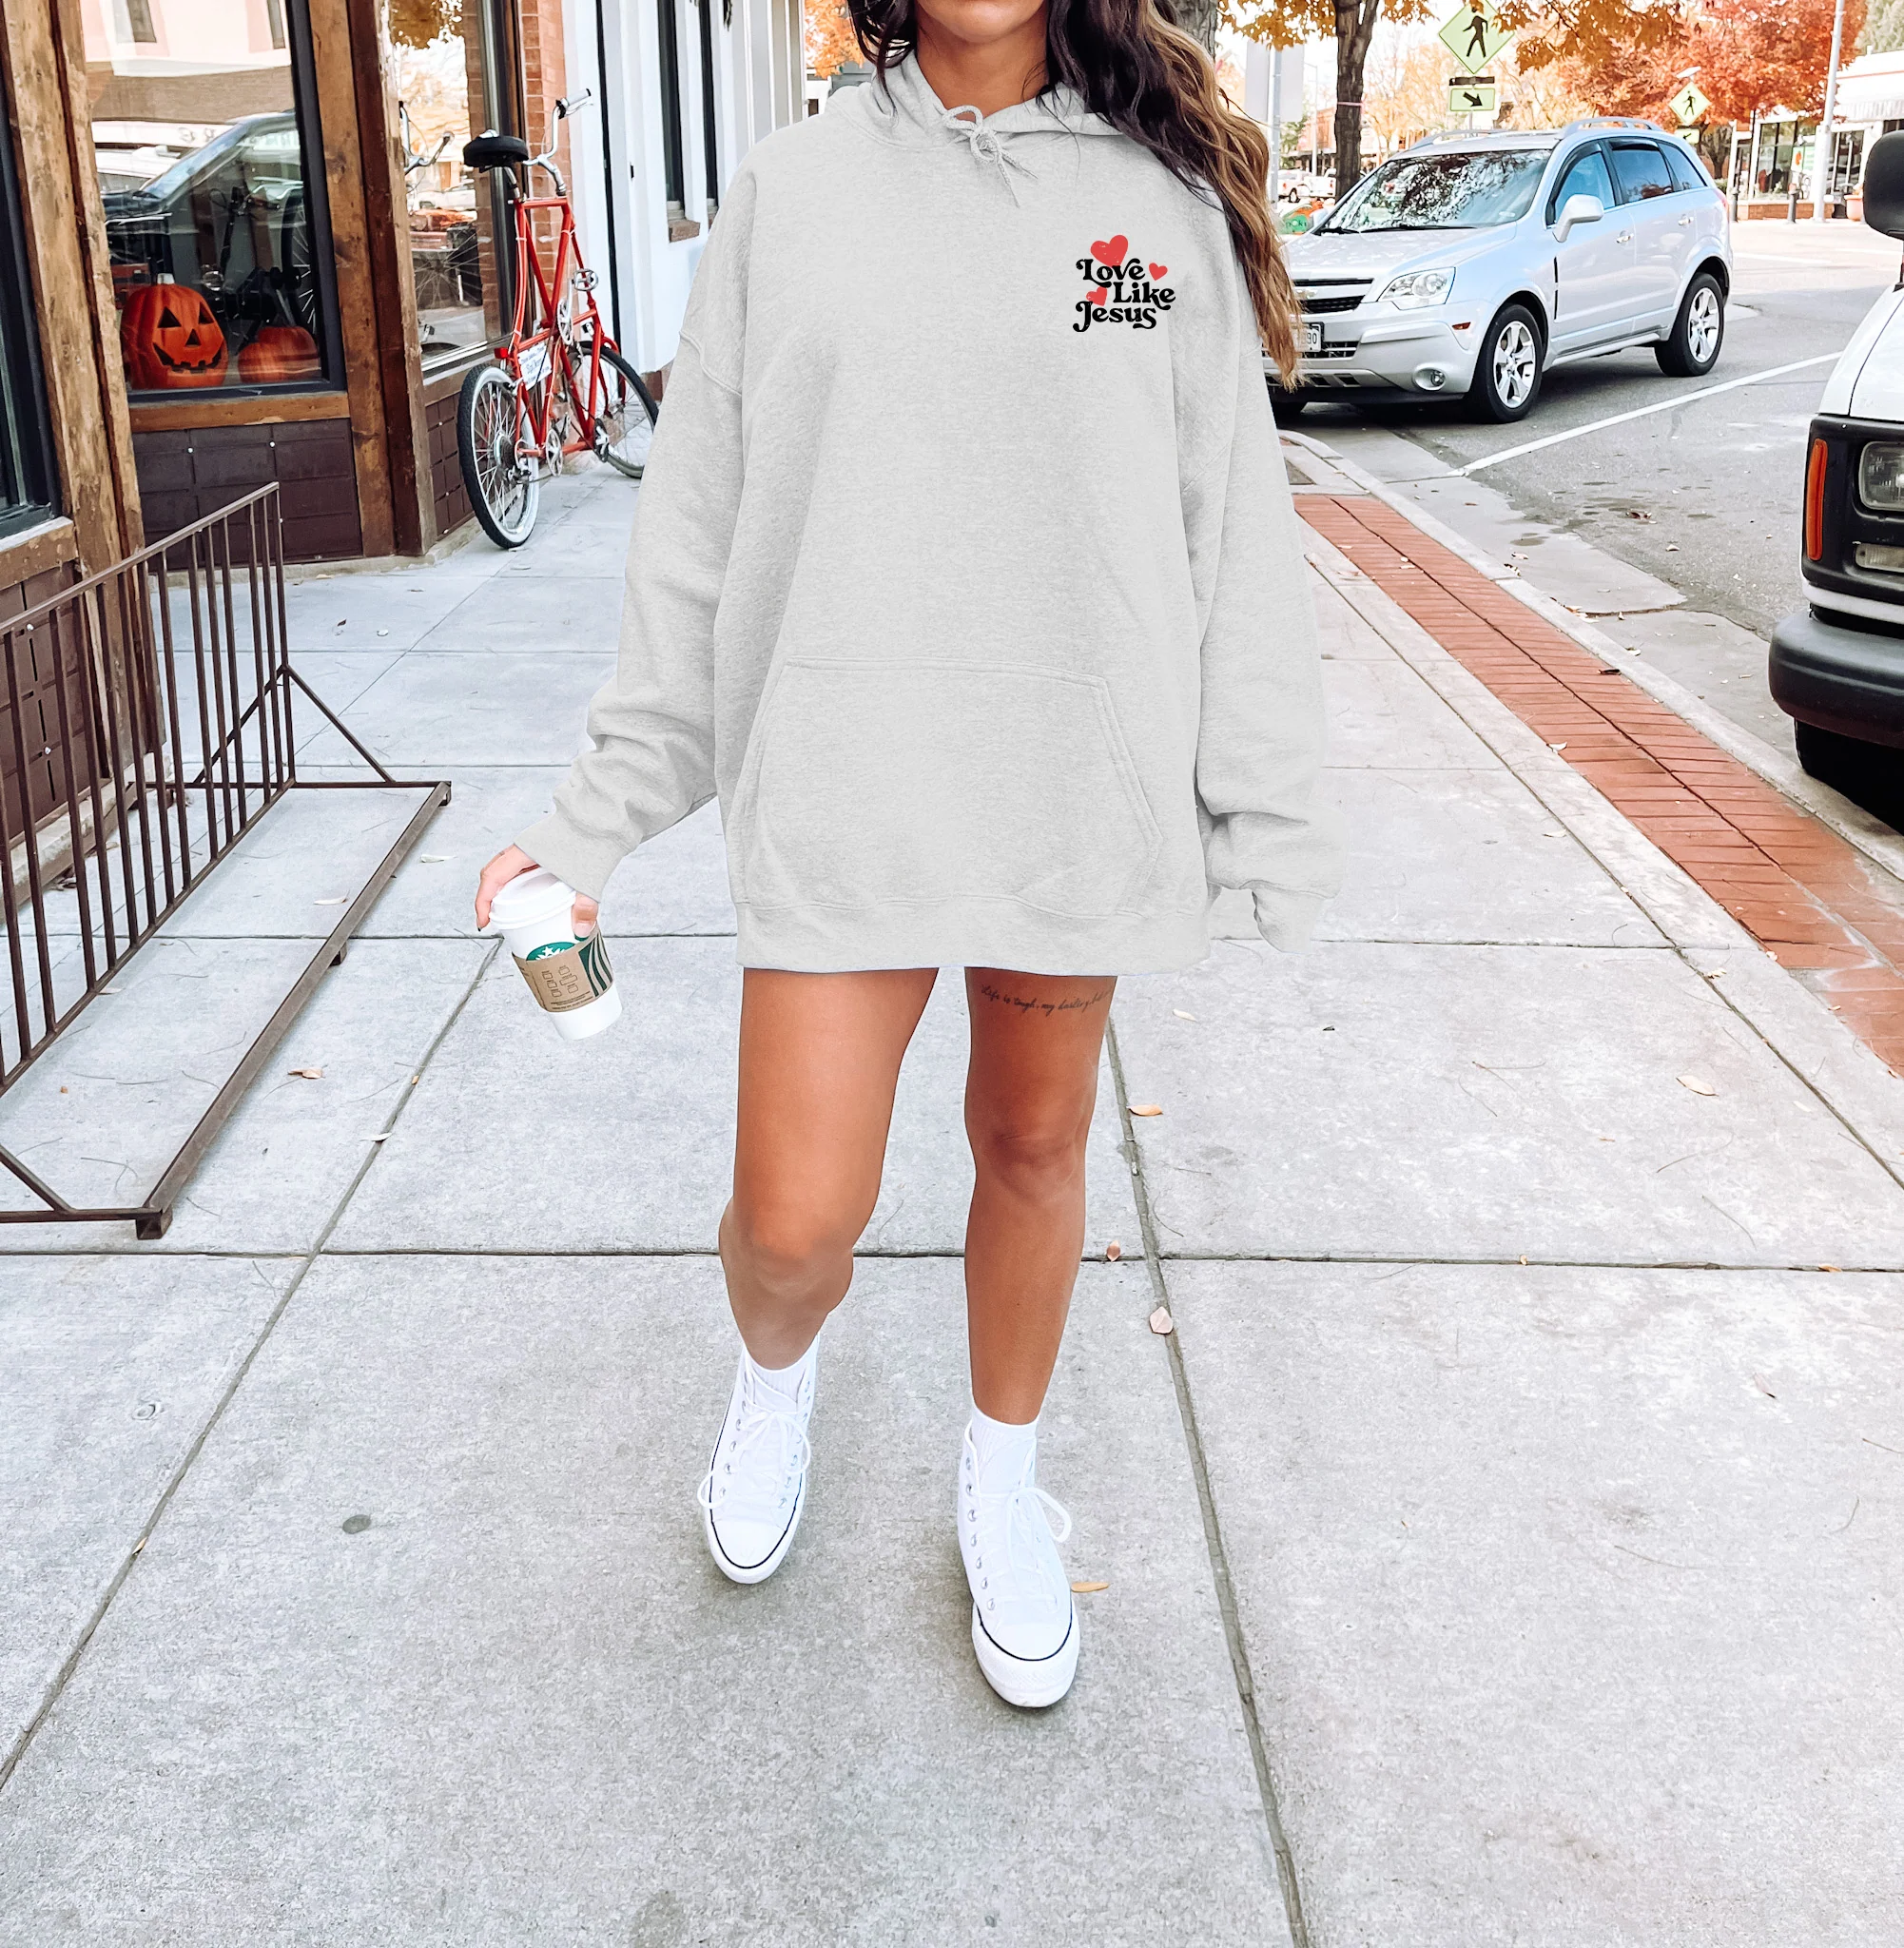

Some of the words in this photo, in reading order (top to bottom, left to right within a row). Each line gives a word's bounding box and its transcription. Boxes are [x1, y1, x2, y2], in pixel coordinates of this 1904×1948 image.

[1076, 258, 1145, 288] Love
[1113, 282, 1175, 310] Like
[1073, 301, 1156, 332] Jesus
[1041, 1003, 1055, 1017] my
